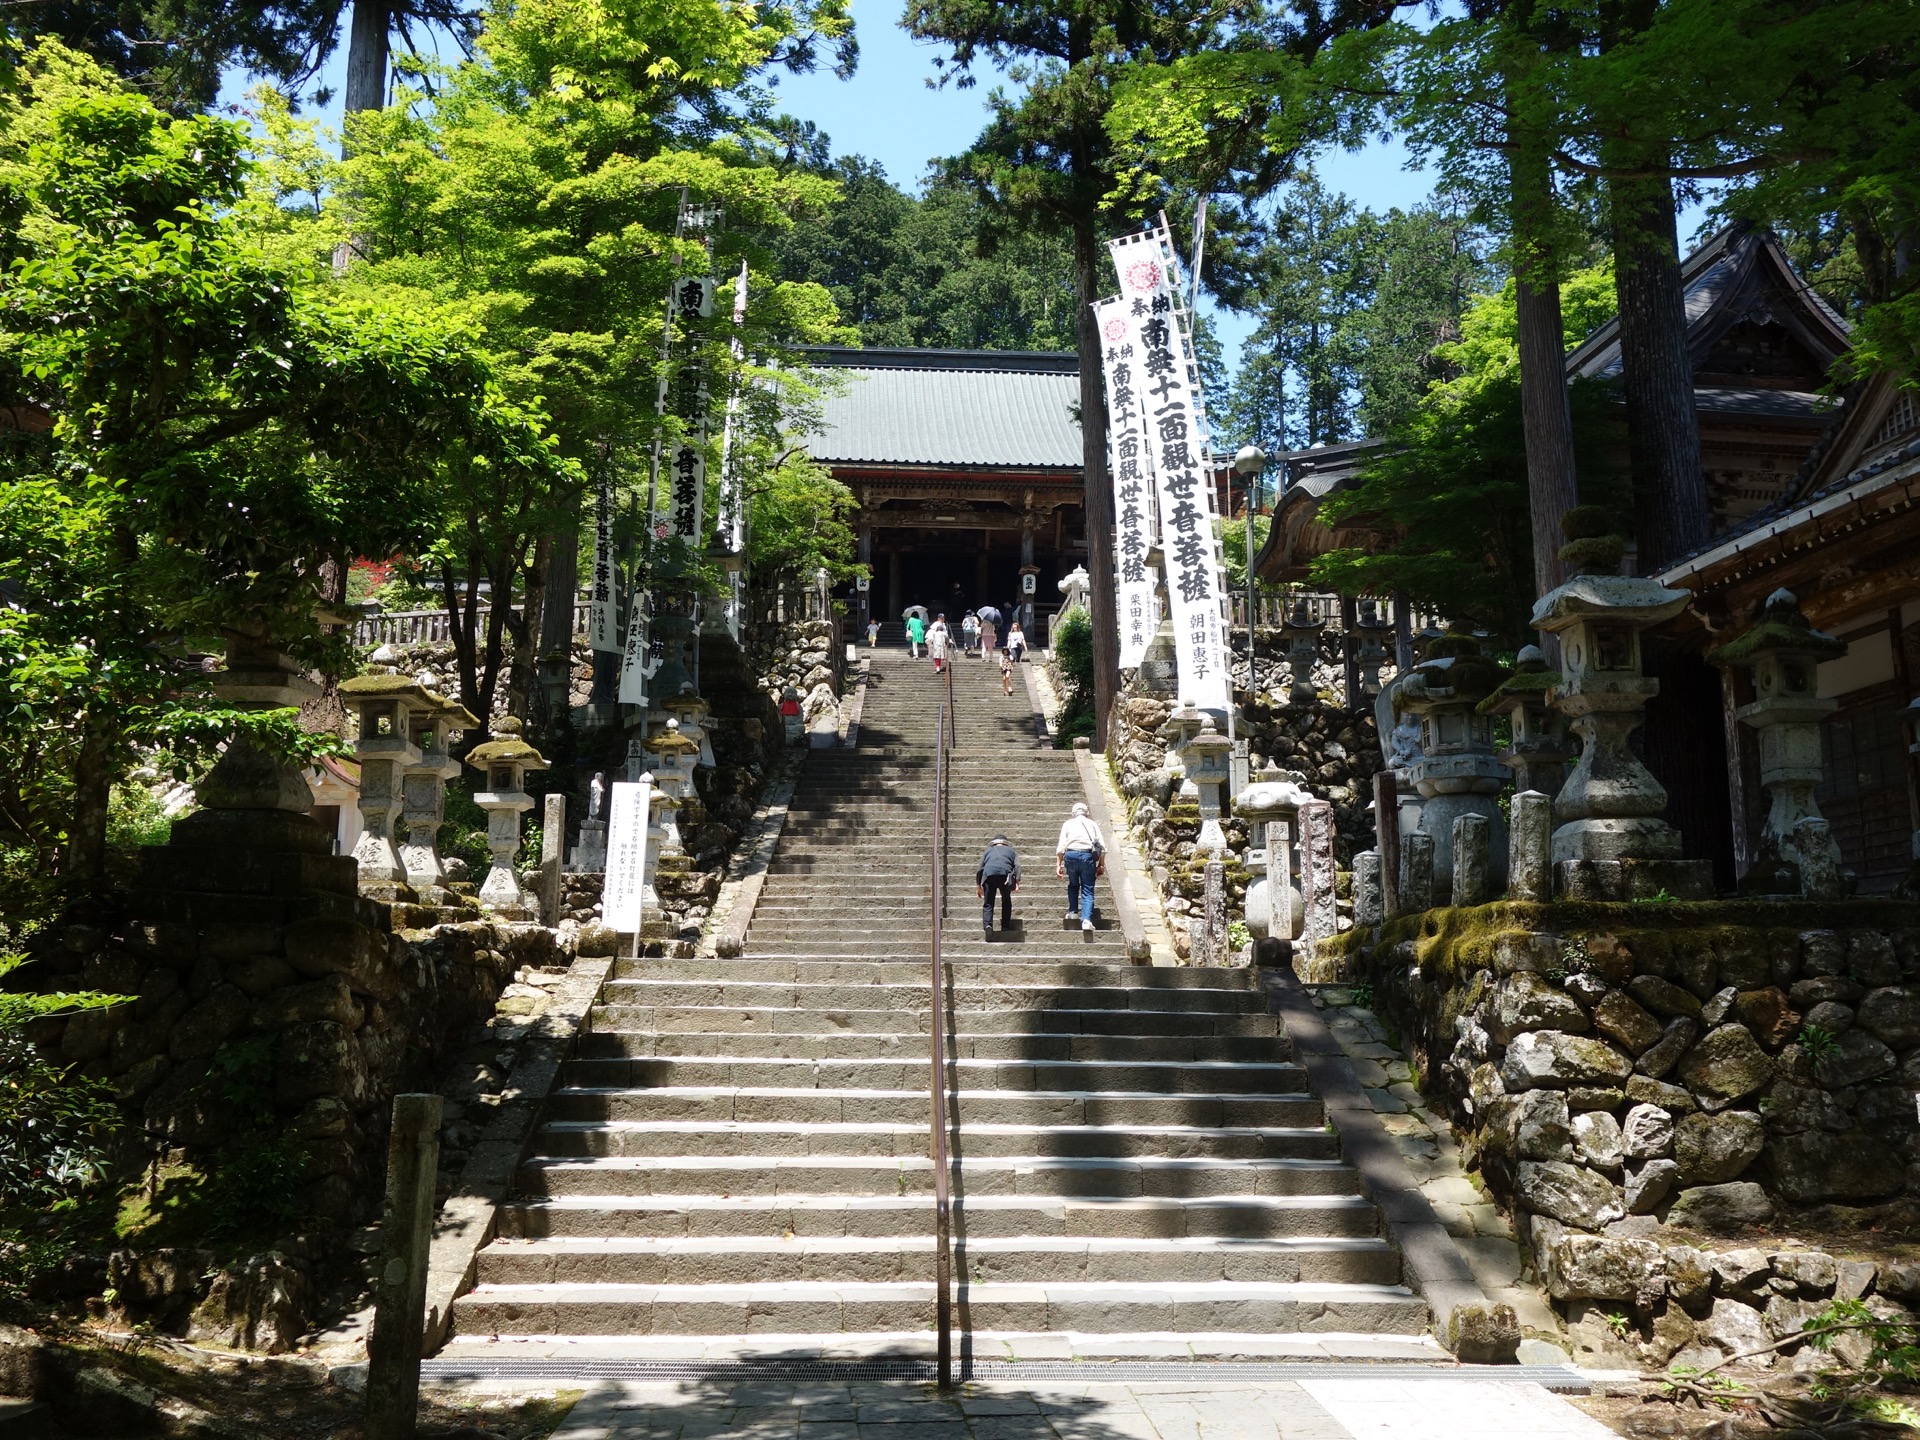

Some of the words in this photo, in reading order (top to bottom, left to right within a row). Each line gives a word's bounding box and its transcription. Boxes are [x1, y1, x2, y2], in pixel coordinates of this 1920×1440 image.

[1130, 293, 1170, 318] 奉納
[1106, 343, 1134, 364] 奉納
[1112, 363, 1146, 583] 南無十一面観世音菩薩
[1140, 318, 1212, 604] 南無十一面観世音菩薩
[1129, 593, 1145, 647] 栗田幸典
